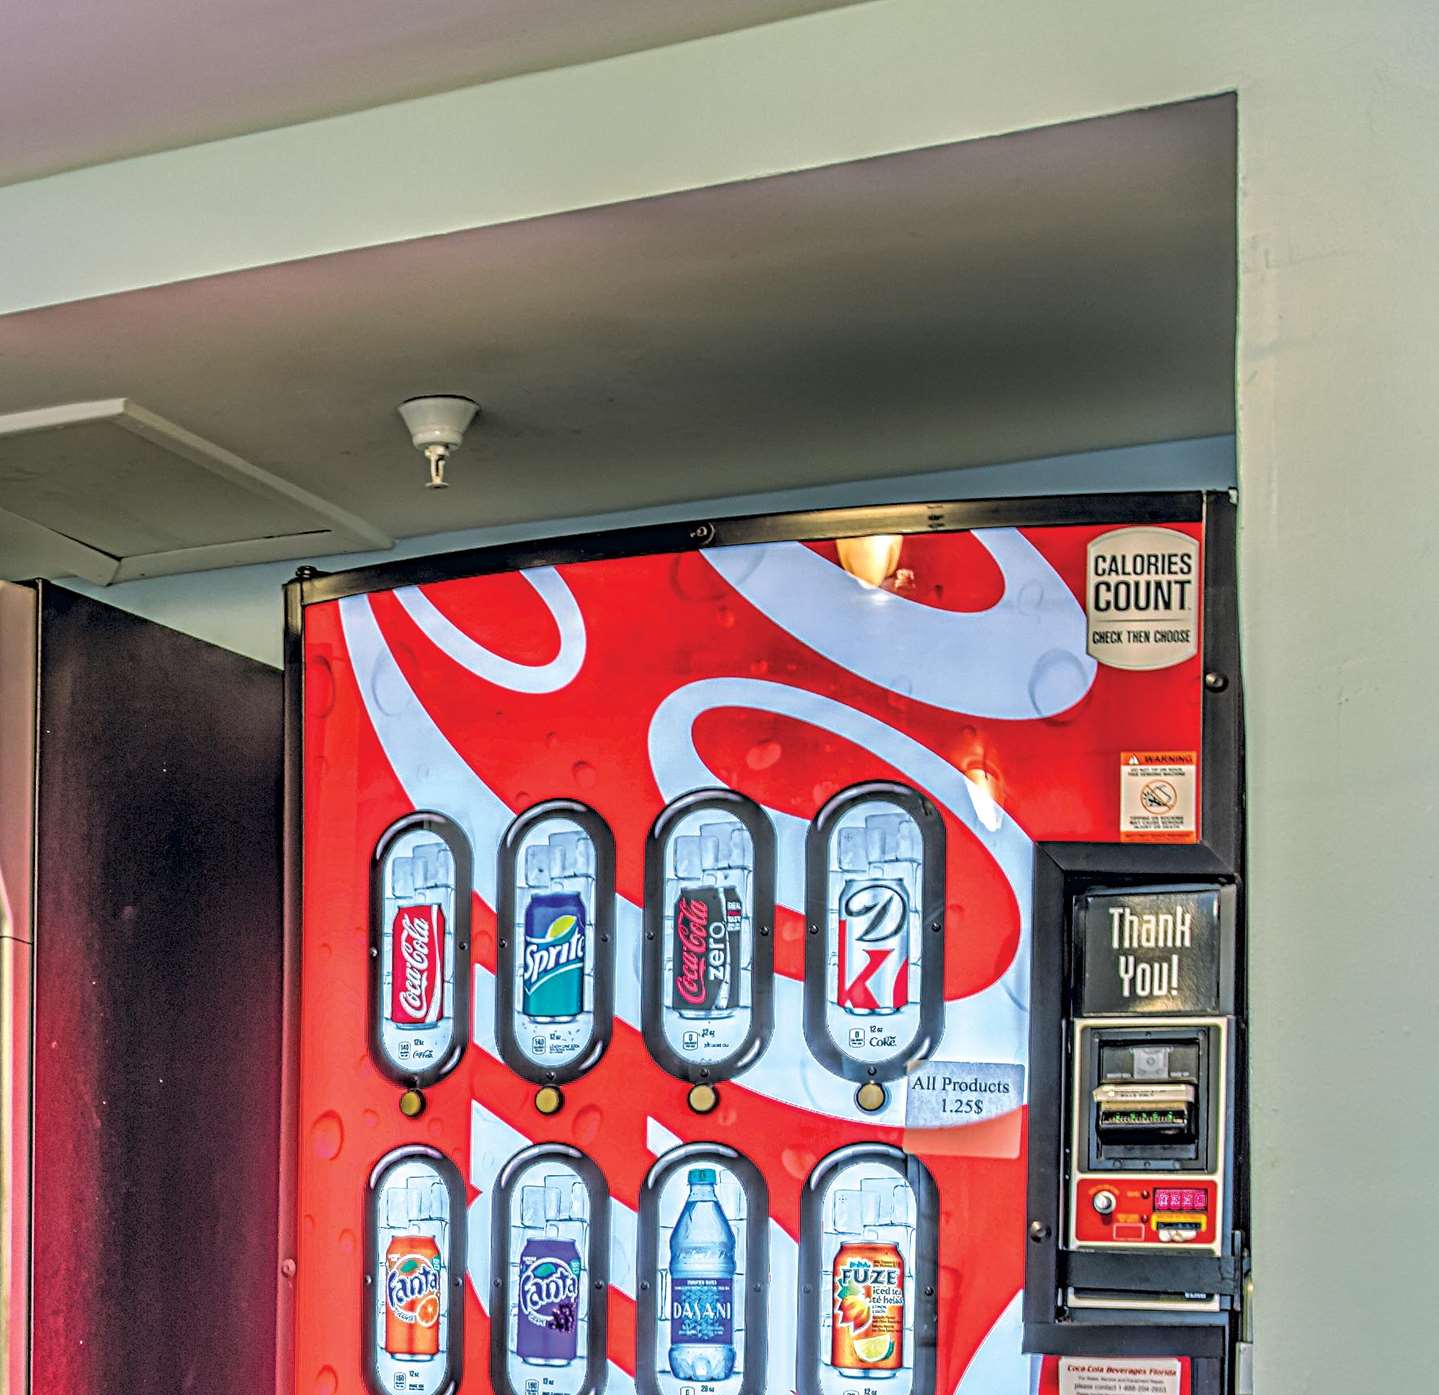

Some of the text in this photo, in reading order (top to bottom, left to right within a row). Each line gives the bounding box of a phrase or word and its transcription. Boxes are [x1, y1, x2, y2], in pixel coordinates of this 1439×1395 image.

[1093, 553, 1192, 577] CALORIES
[1093, 580, 1192, 612] COUNT
[1092, 629, 1191, 645] CHECK THEN CHOOSE
[1144, 755, 1193, 763] WARNING
[1109, 906, 1192, 949] Thank
[525, 930, 585, 982] Sprite
[709, 921, 727, 981] zero
[1118, 954, 1179, 997] You!
[912, 1076, 1010, 1093] All Products
[941, 1099, 984, 1115] 1.25$
[842, 1269, 897, 1285] FUZE
[872, 1286, 890, 1295] iced
[673, 1302, 731, 1320] DASANI
[1106, 1365, 1147, 1376] Beverages
[1149, 1367, 1176, 1376] Florida
